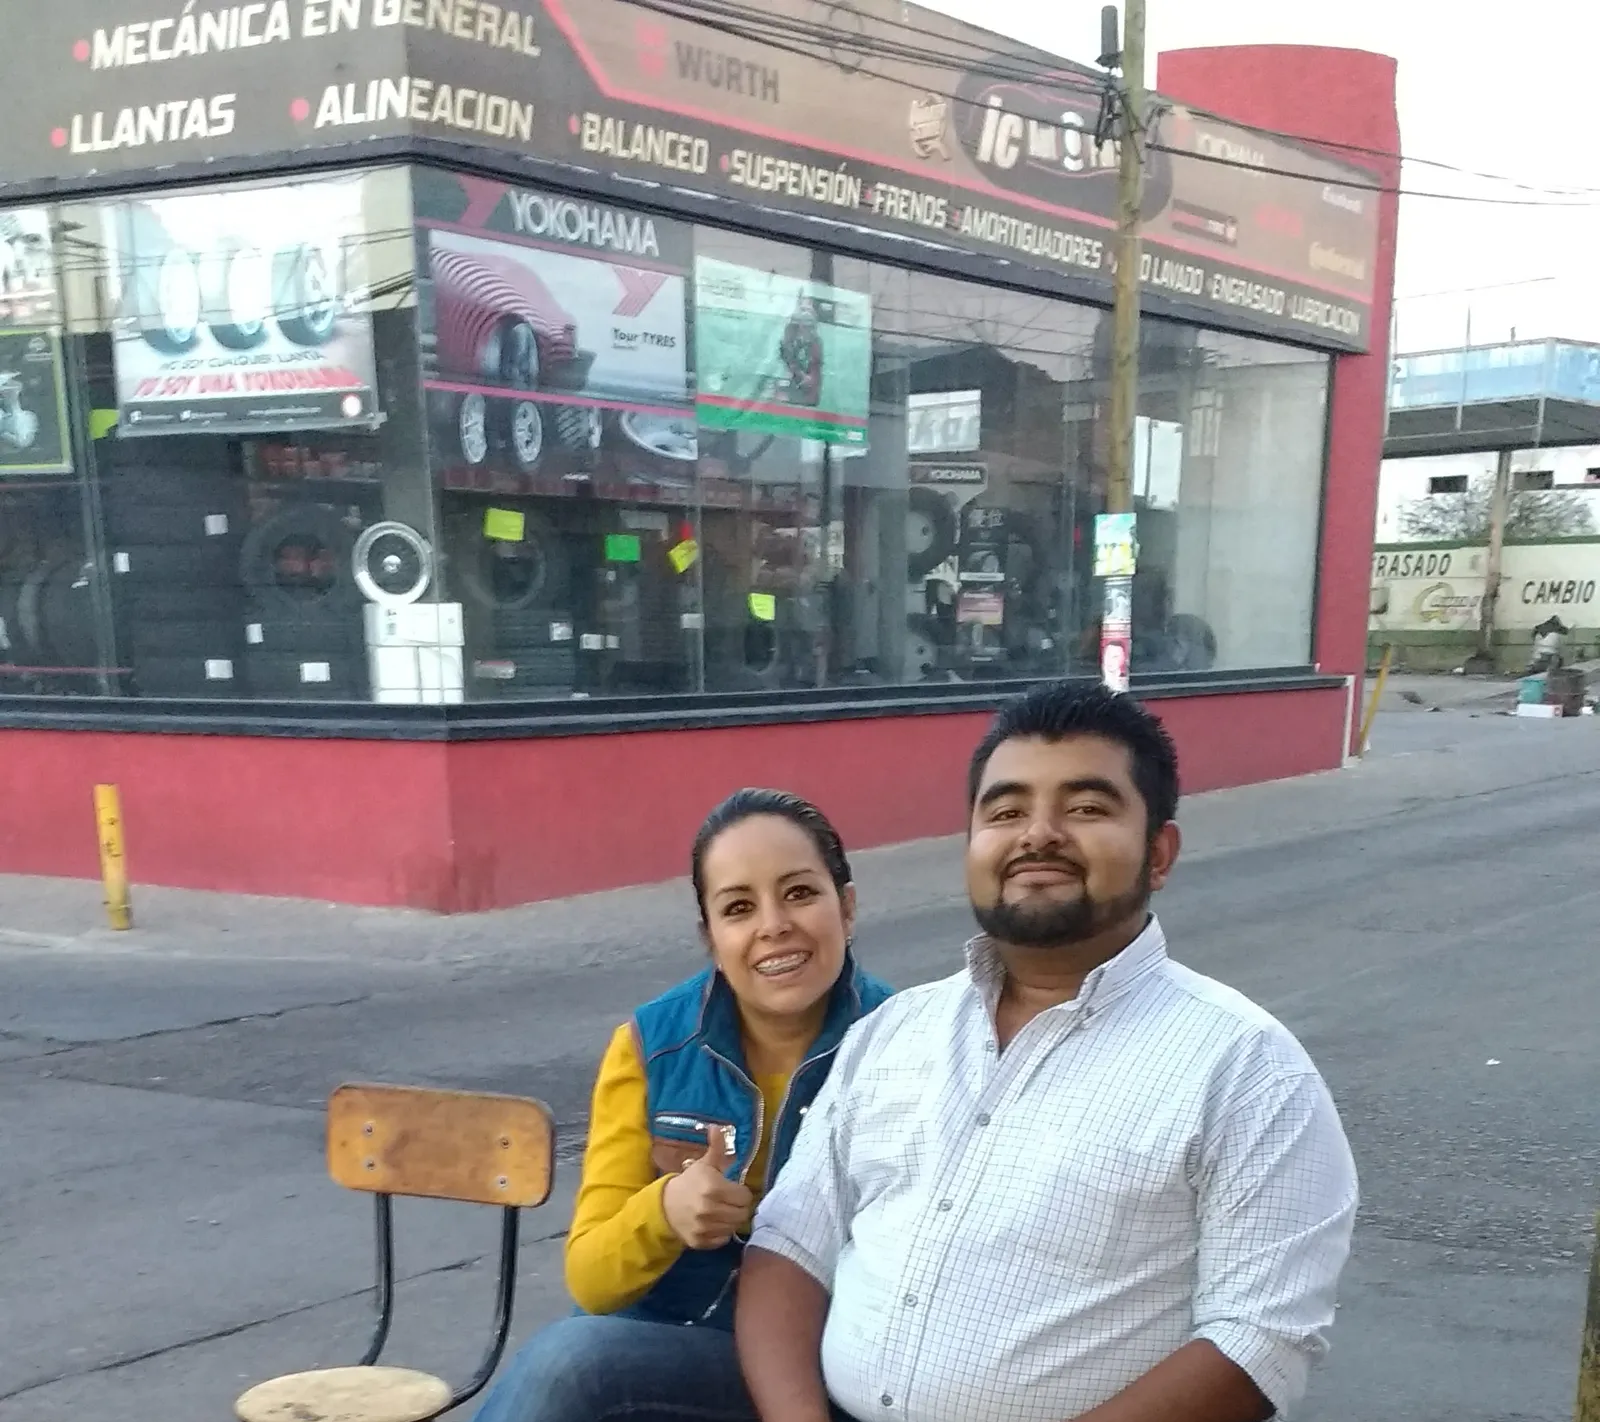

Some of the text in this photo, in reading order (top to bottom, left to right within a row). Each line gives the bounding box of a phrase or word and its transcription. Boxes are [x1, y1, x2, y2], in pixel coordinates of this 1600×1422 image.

[91, 0, 541, 70] MECÁNICA EN GENERAL
[70, 93, 236, 154] LLANTAS
[314, 75, 535, 142] ALINEACION
[581, 112, 709, 175] BALANCEO
[730, 150, 862, 208] SUSPENSIÓN
[872, 182, 949, 229] FRENOS
[508, 190, 660, 258] YOKOHAMA
[961, 205, 1103, 269] AMORTIGUADORES
[1152, 257, 1205, 295] LAVADO
[1373, 553, 1452, 577] RASADO
[1521, 579, 1597, 605] CAMBIO
